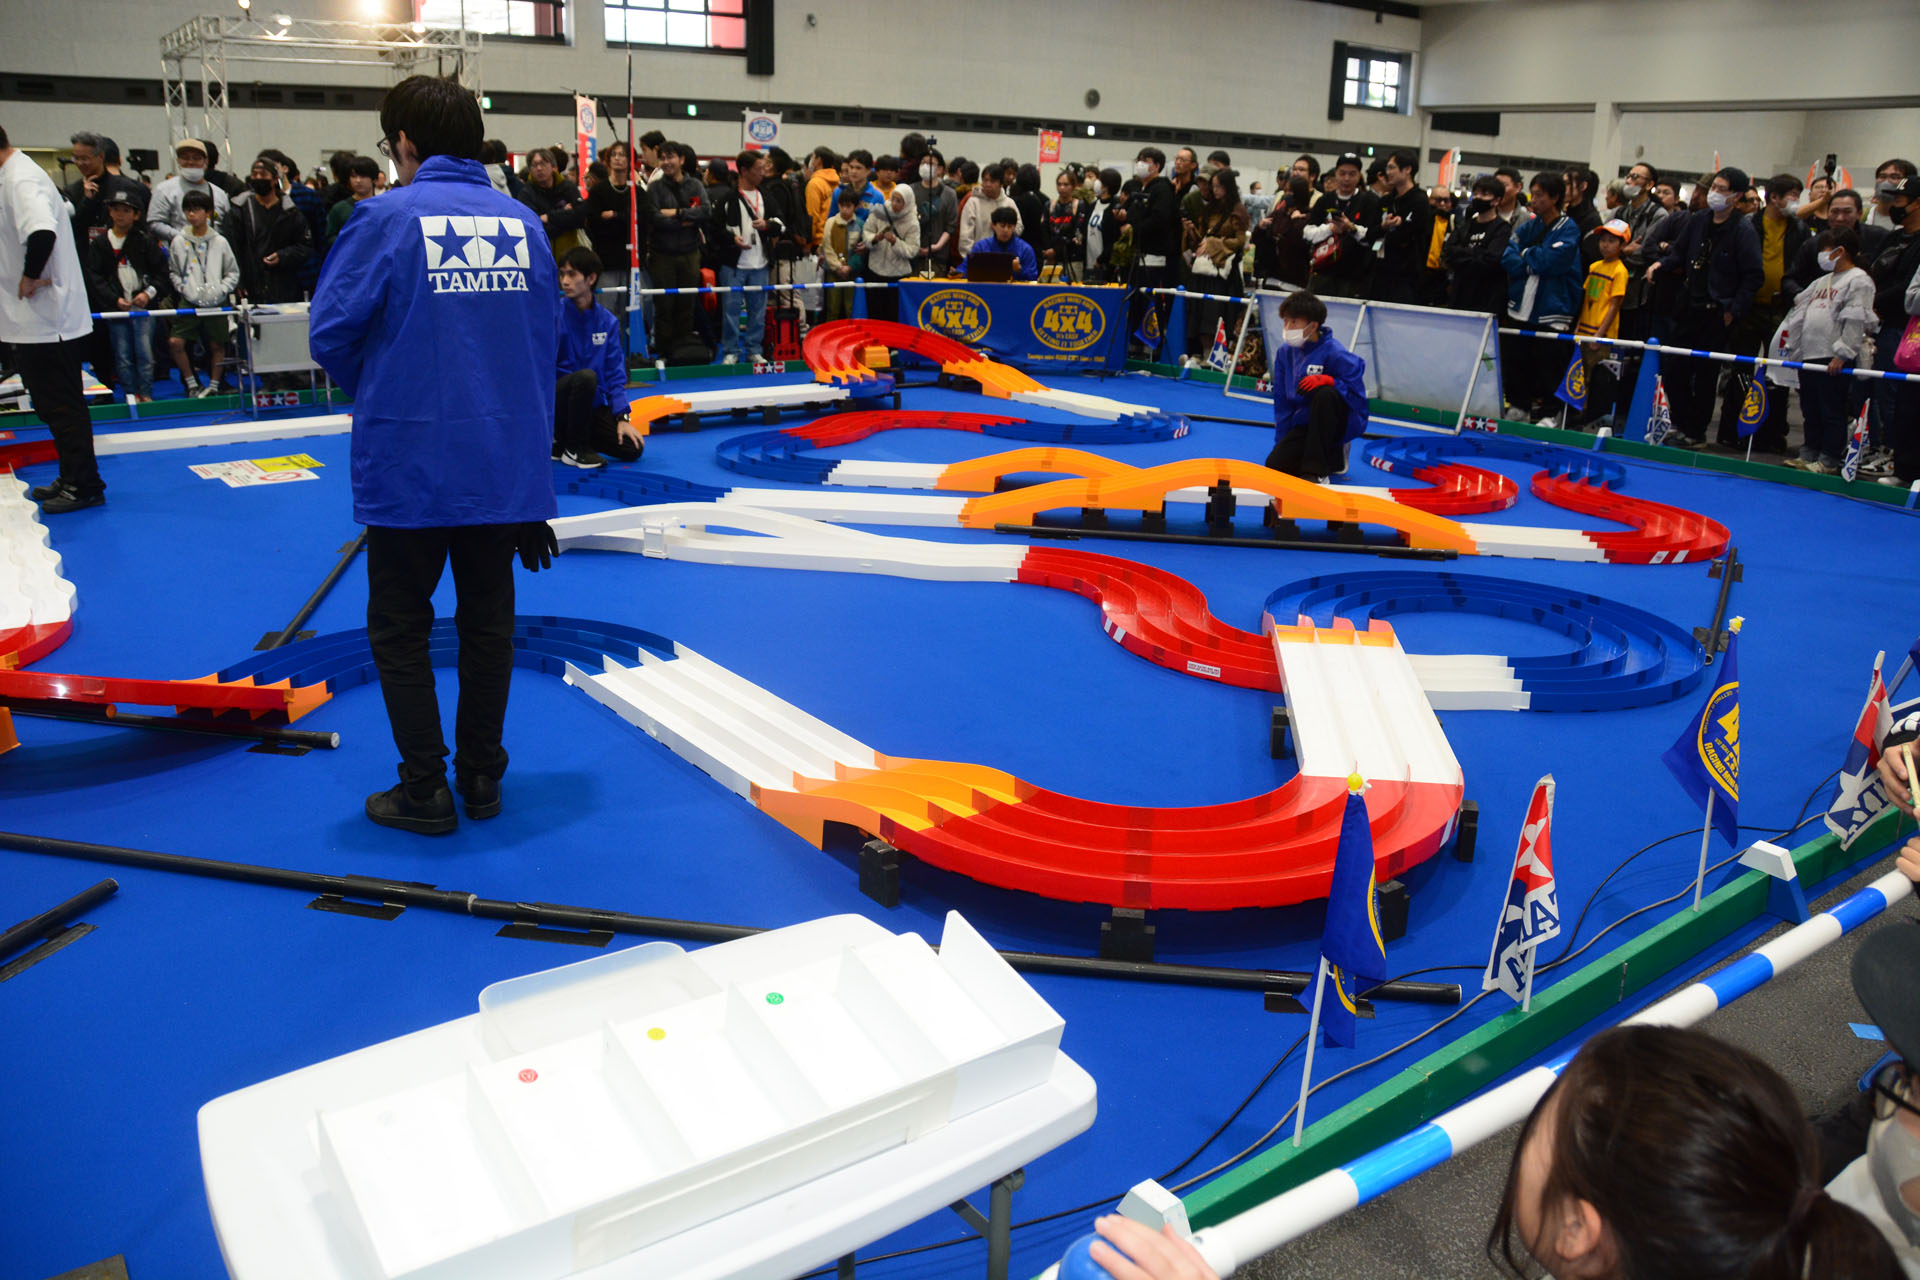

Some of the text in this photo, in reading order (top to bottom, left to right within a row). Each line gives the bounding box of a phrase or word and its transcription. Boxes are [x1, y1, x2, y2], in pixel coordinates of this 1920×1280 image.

[428, 271, 529, 293] TAMIYA
[1043, 309, 1093, 334] 4x4
[1704, 742, 1726, 774] RACING
